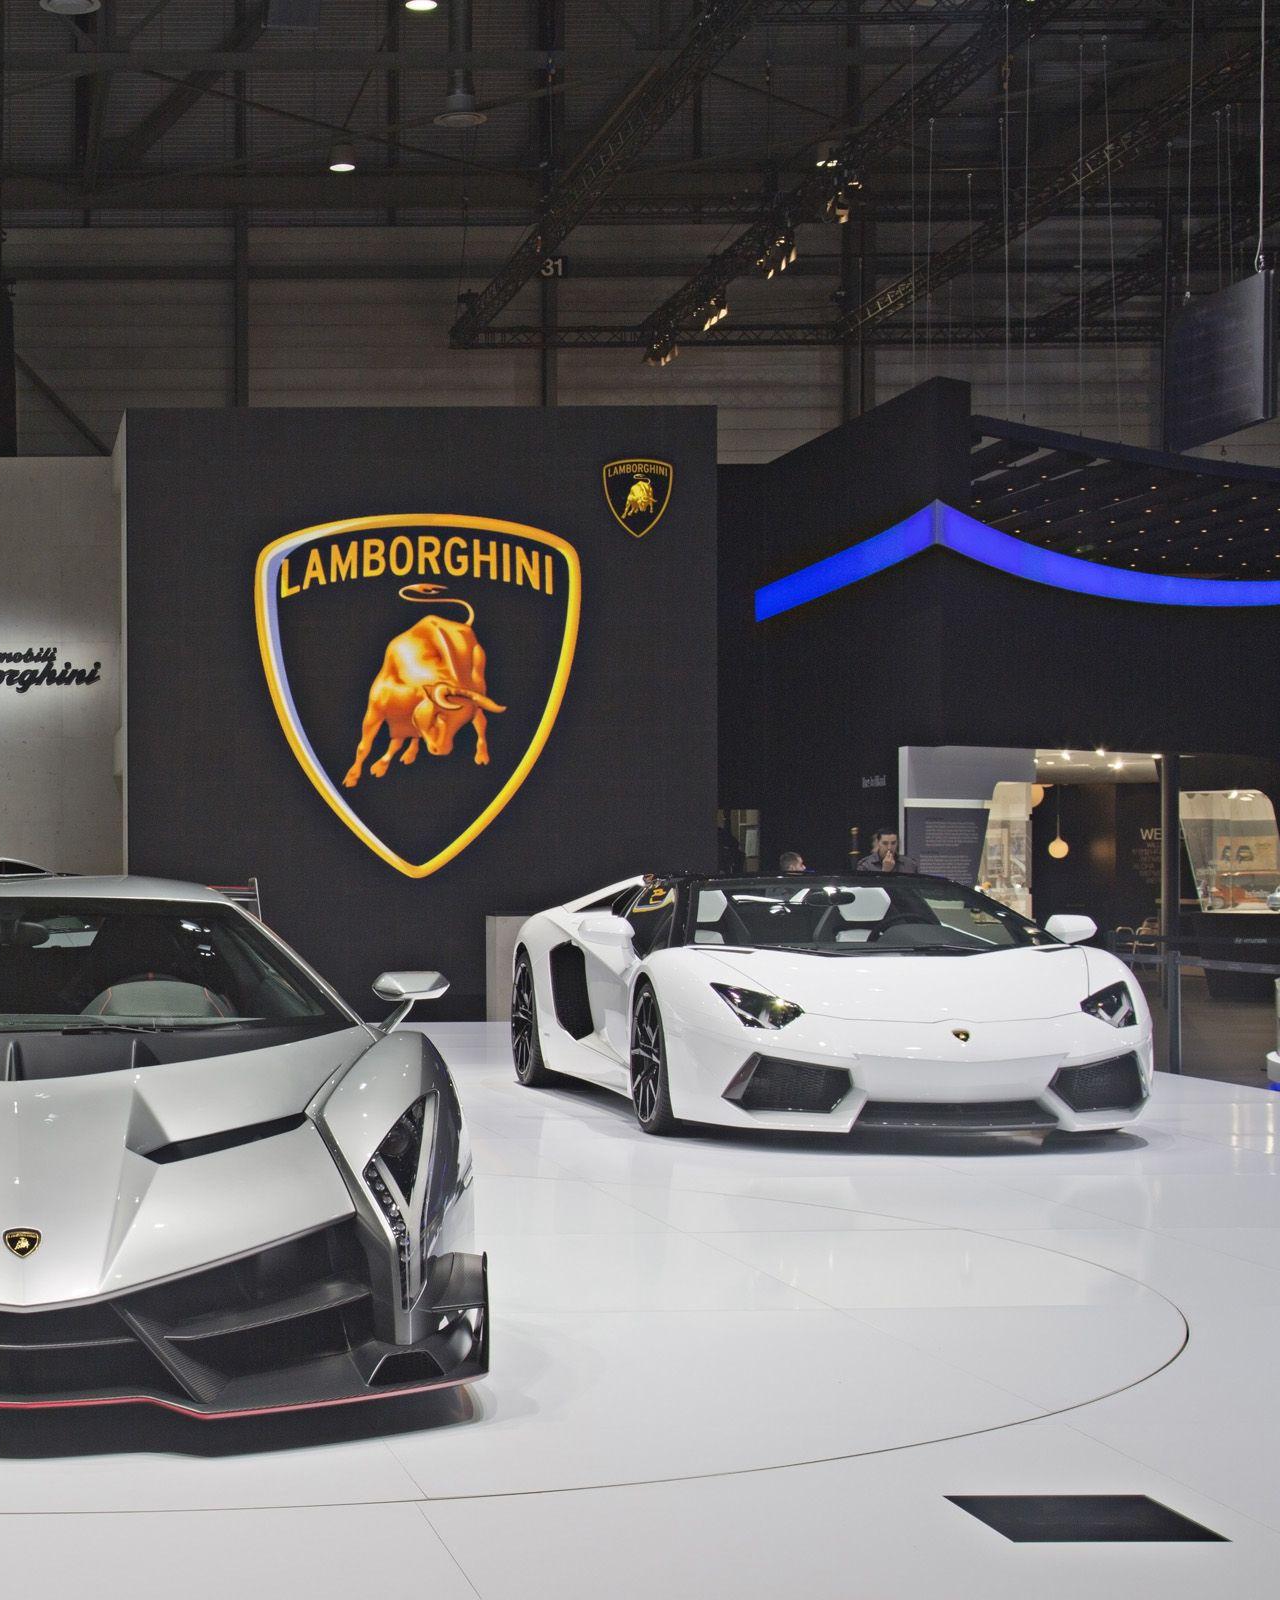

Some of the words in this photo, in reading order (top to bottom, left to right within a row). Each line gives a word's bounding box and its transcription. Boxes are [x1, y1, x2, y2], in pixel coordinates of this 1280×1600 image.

[540, 258, 562, 276] 31
[608, 463, 668, 478] LAMBORGHINI
[280, 535, 553, 599] LAMBORGHINI
